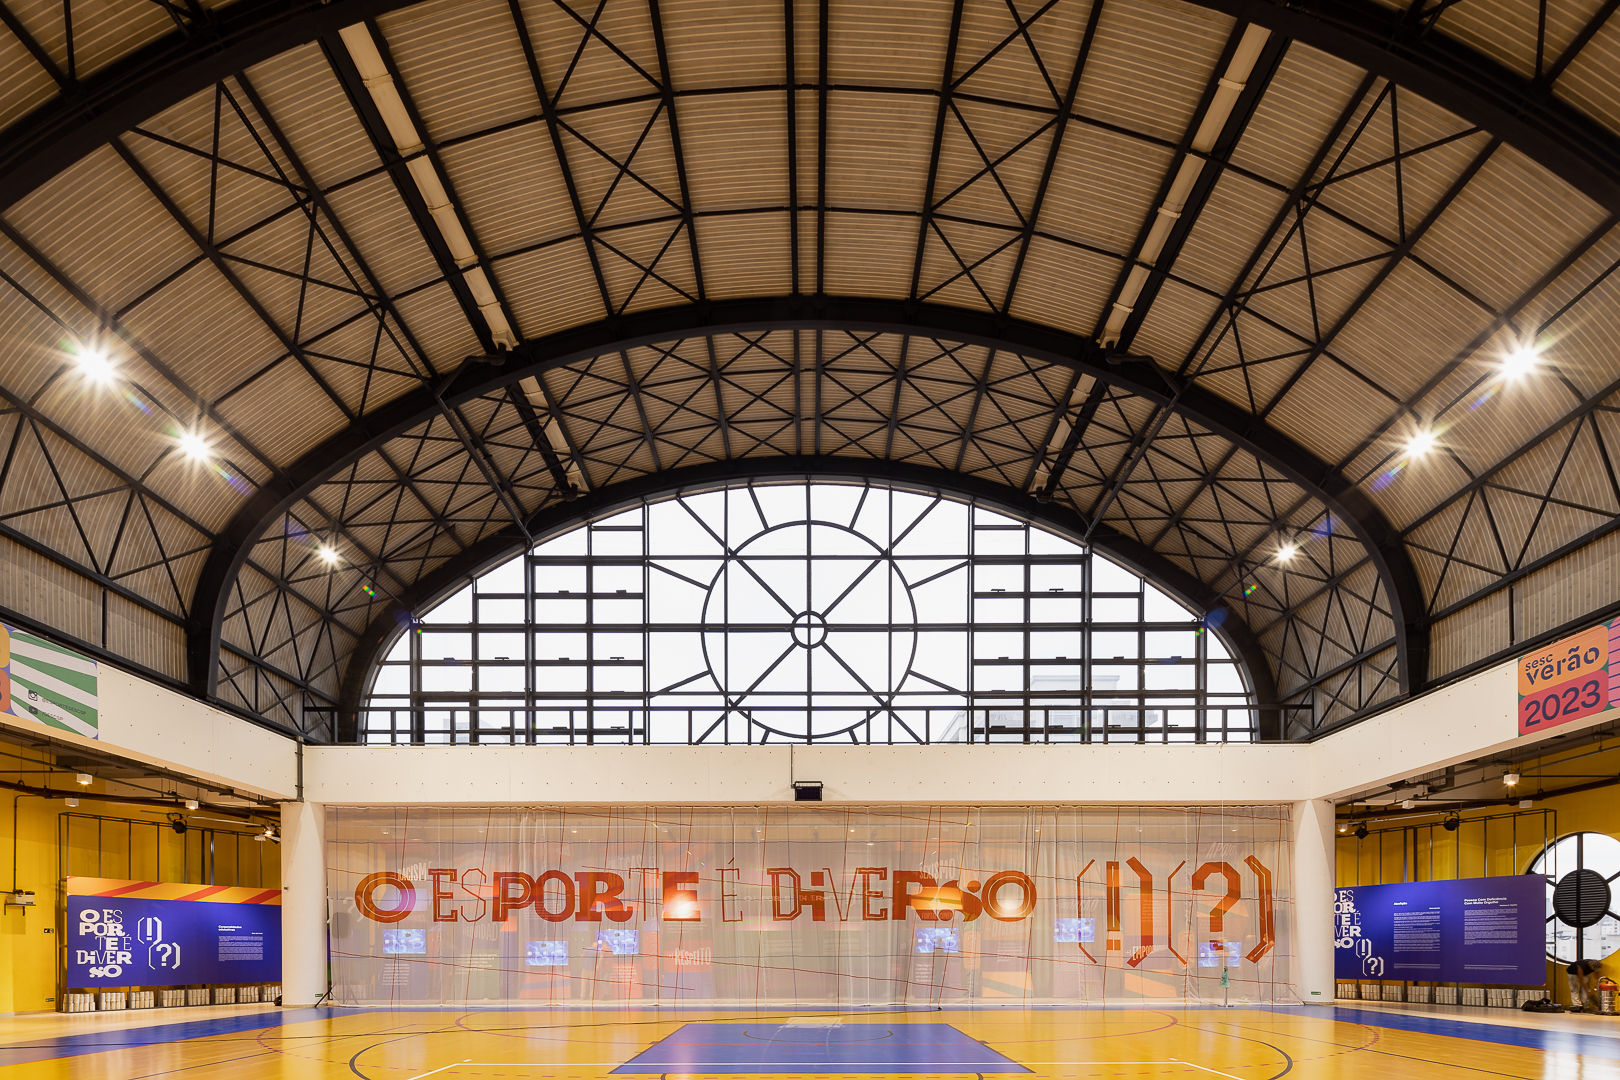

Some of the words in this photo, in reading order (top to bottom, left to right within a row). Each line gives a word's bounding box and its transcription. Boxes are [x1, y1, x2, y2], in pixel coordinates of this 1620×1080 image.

[1525, 653, 1553, 672] sesc
[1526, 645, 1600, 686] verão
[1525, 680, 1601, 728] 2023
[354, 871, 416, 923] O
[428, 867, 702, 923] ESPORTE
[715, 857, 744, 922] É
[79, 909, 100, 923] O
[1334, 901, 1356, 914] OR
[674, 946, 711, 966] RESPEITO
